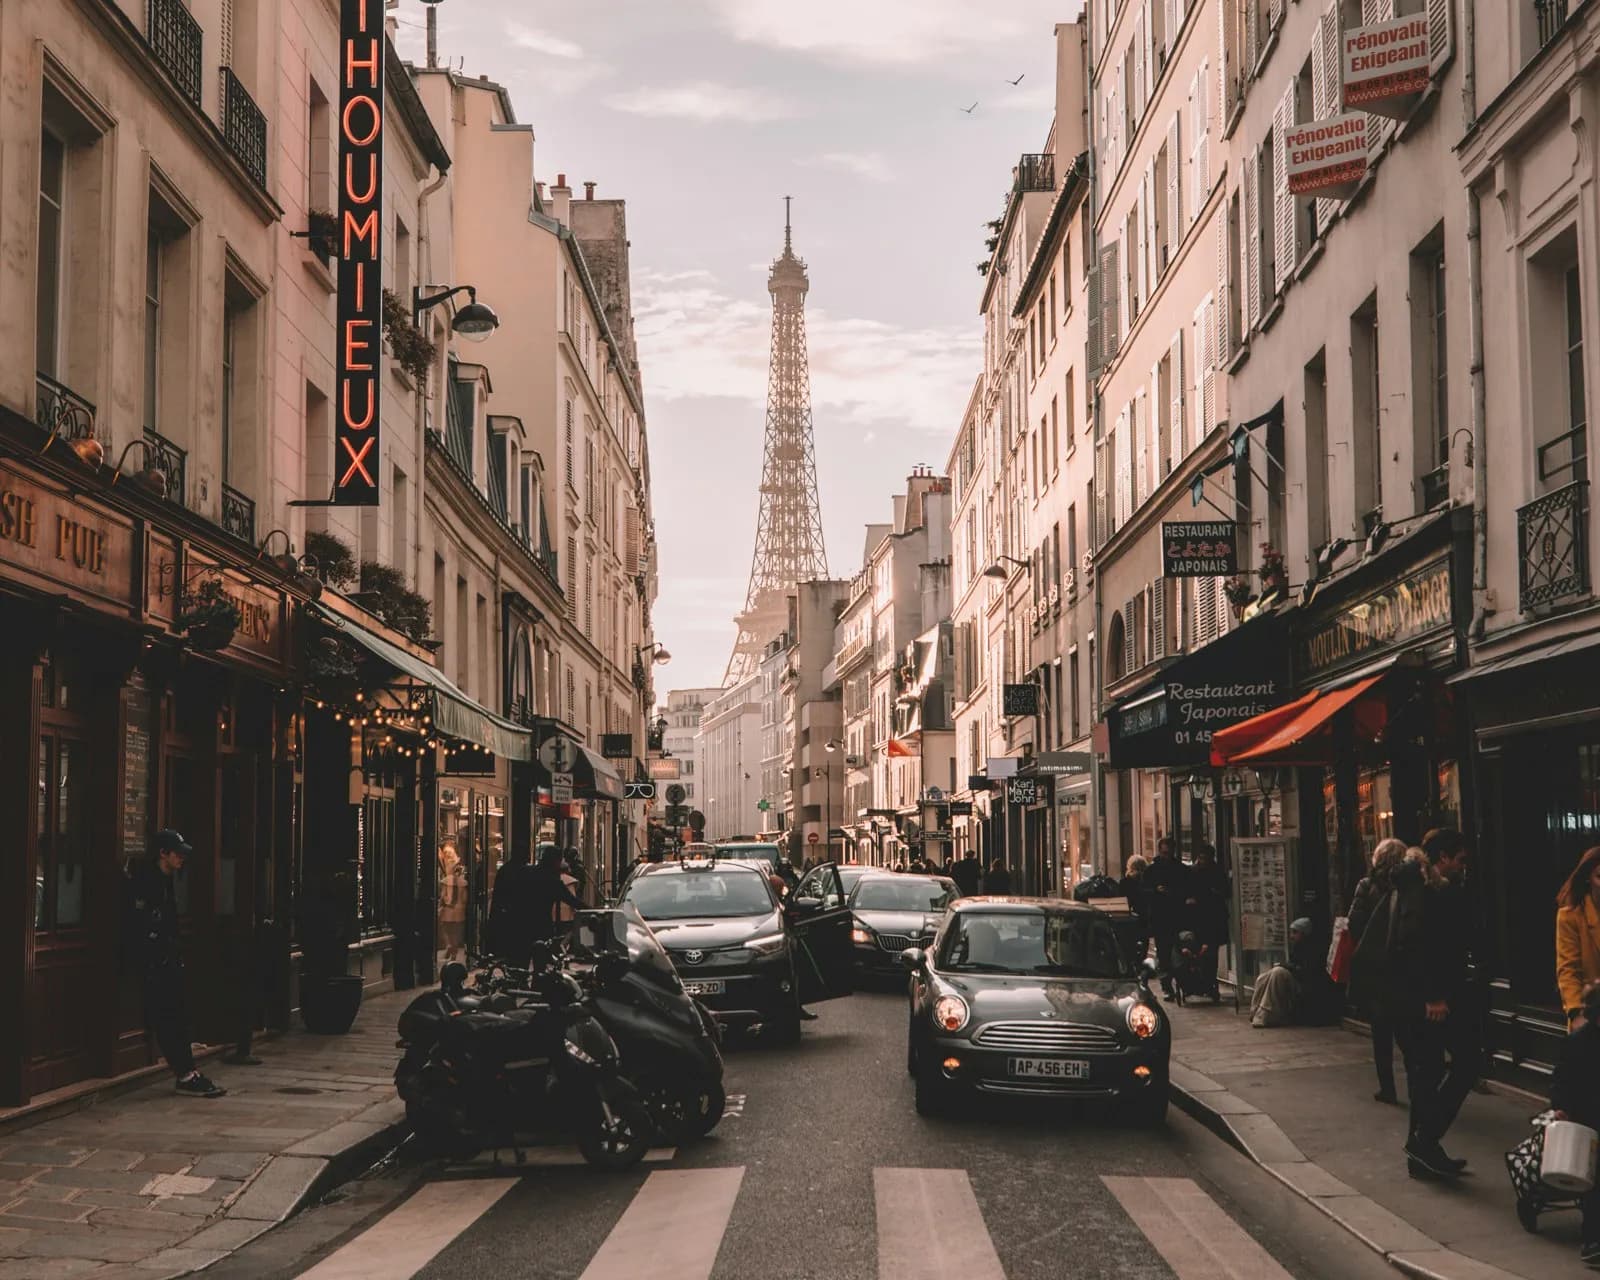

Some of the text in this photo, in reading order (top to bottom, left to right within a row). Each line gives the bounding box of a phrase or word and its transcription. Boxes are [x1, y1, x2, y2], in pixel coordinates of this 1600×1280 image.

[1164, 524, 1232, 537] RESTAURANT
[1171, 560, 1228, 573] JAPONAIS
[1308, 623, 1350, 668] MOULIN
[1168, 680, 1276, 700] Restaurant
[1180, 701, 1266, 724] Japonais
[1175, 730, 1212, 744] 01 45
[1013, 779, 1035, 789] Karl
[1009, 786, 1035, 796] Marc
[1010, 795, 1035, 804] John
